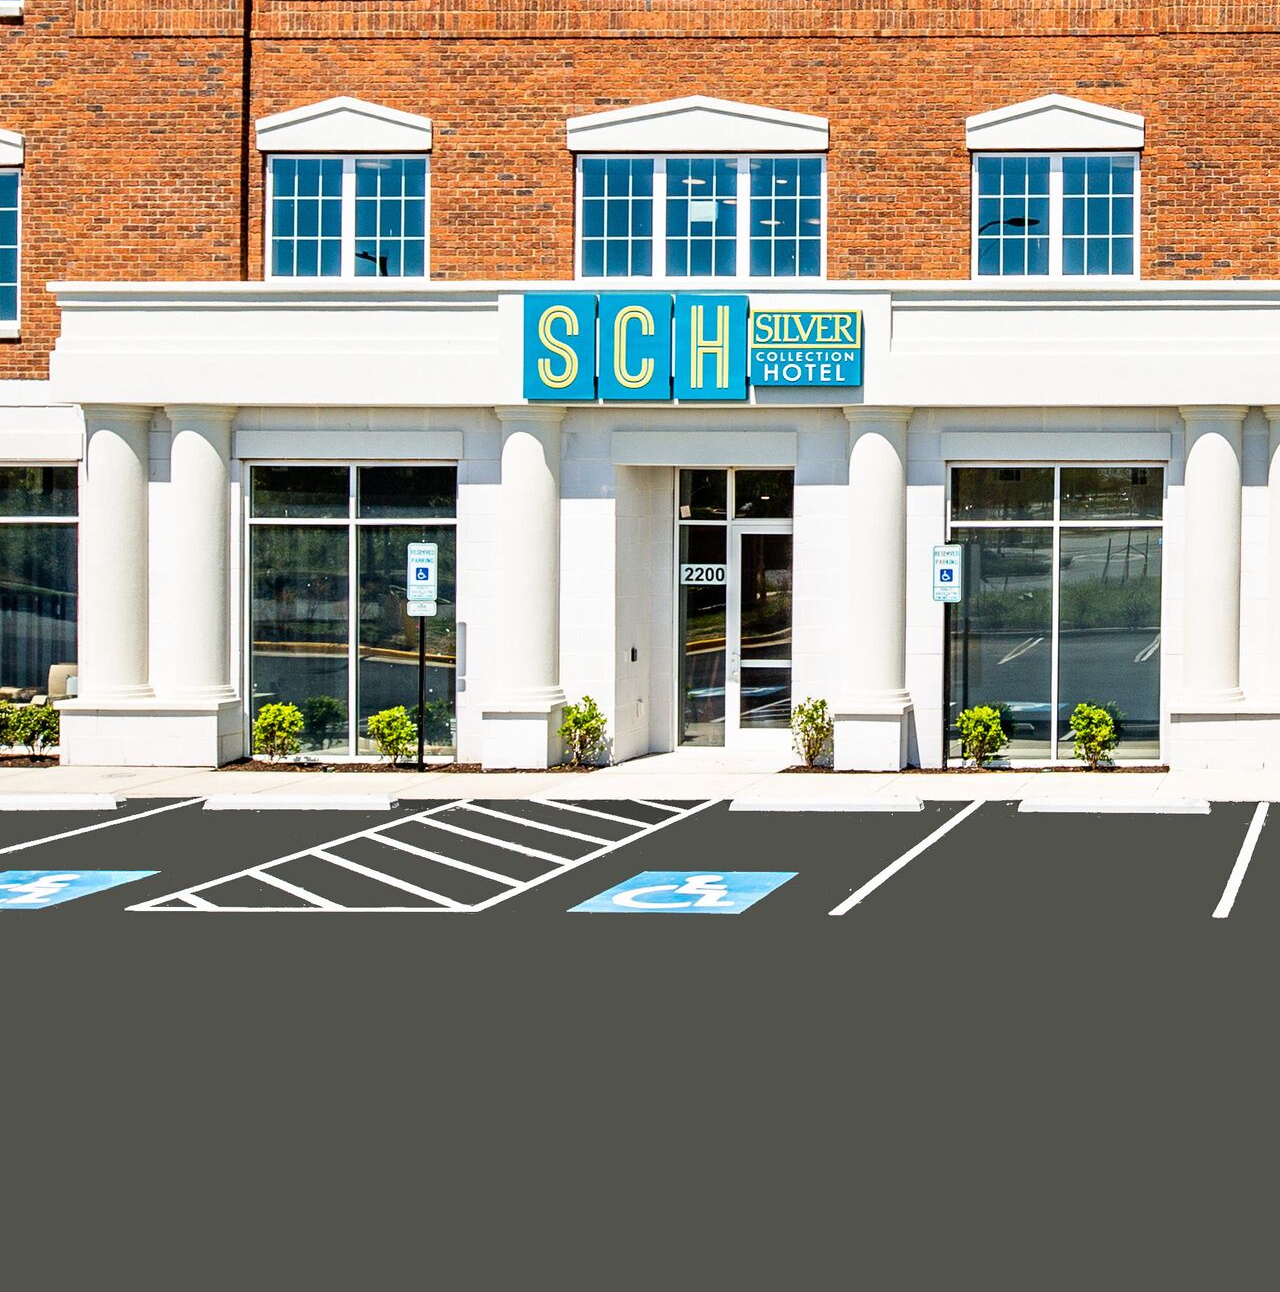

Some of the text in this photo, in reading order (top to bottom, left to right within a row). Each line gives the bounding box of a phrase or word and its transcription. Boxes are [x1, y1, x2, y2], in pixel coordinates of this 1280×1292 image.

[755, 314, 855, 344] SILVER
[537, 305, 729, 389] SCH
[755, 351, 855, 363] COLLECTION
[764, 363, 846, 382] HOTEL
[684, 567, 725, 581] 2200
